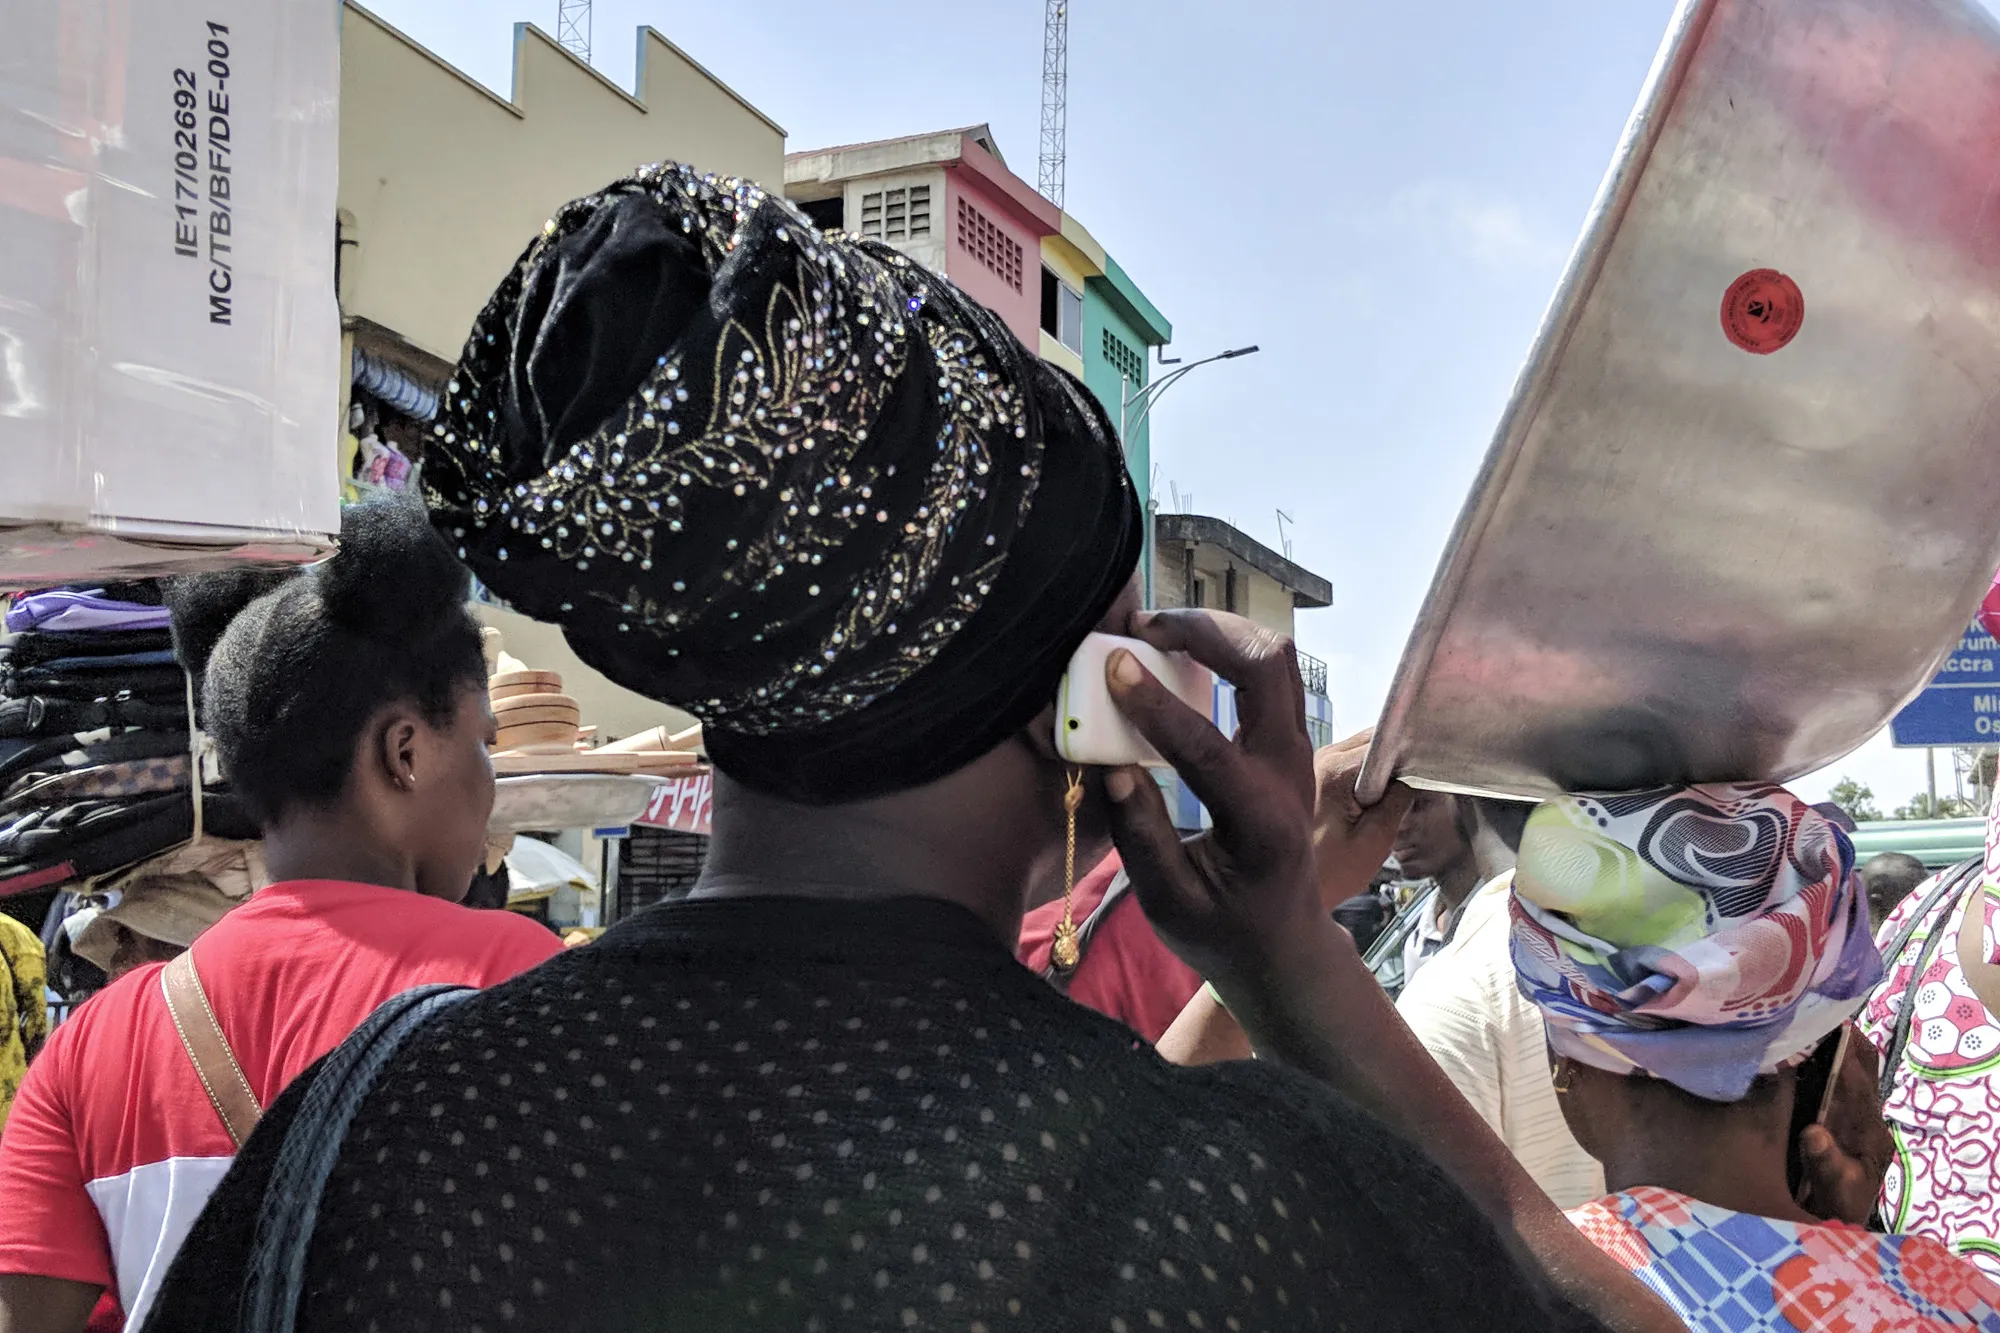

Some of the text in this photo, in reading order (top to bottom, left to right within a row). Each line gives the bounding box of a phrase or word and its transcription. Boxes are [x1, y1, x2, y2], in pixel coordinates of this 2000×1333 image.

[174, 67, 198, 259] IE17/02692
[205, 20, 233, 326] MC/TB/BF/DE-001
[1954, 635, 2000, 652] rum
[1941, 657, 1994, 673] ccra
[1973, 694, 2000, 713] Mi
